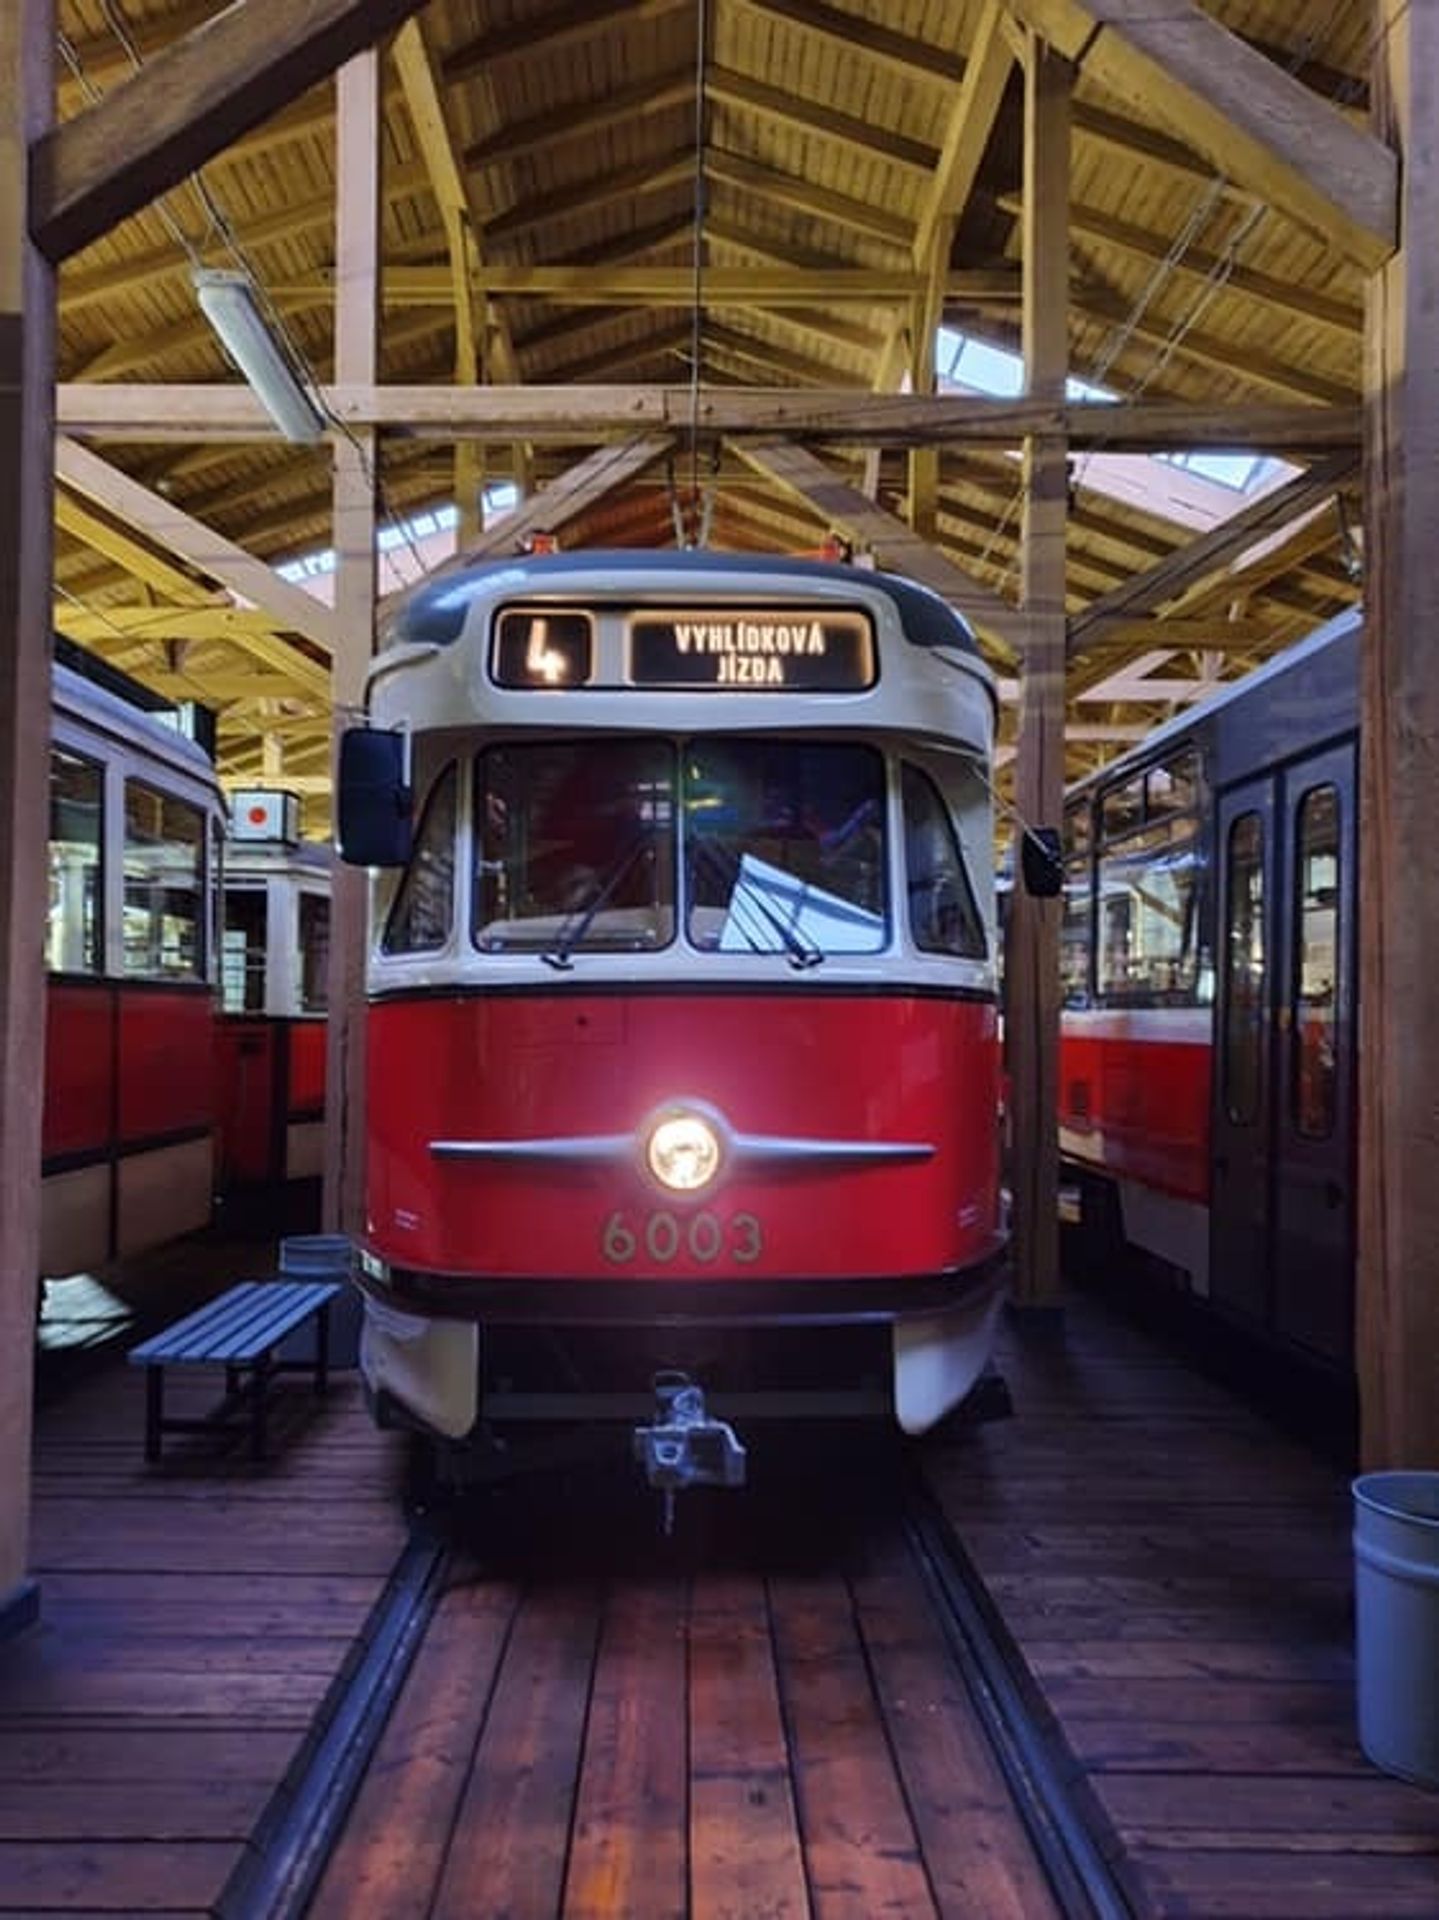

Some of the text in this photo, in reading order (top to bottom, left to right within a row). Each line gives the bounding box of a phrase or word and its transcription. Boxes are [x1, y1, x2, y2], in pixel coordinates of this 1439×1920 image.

[527, 618, 566, 684] 4
[674, 620, 825, 654] VYHLÍDKOVÁ
[716, 652, 785, 683] JÍZDA
[601, 1210, 764, 1264] 6003
